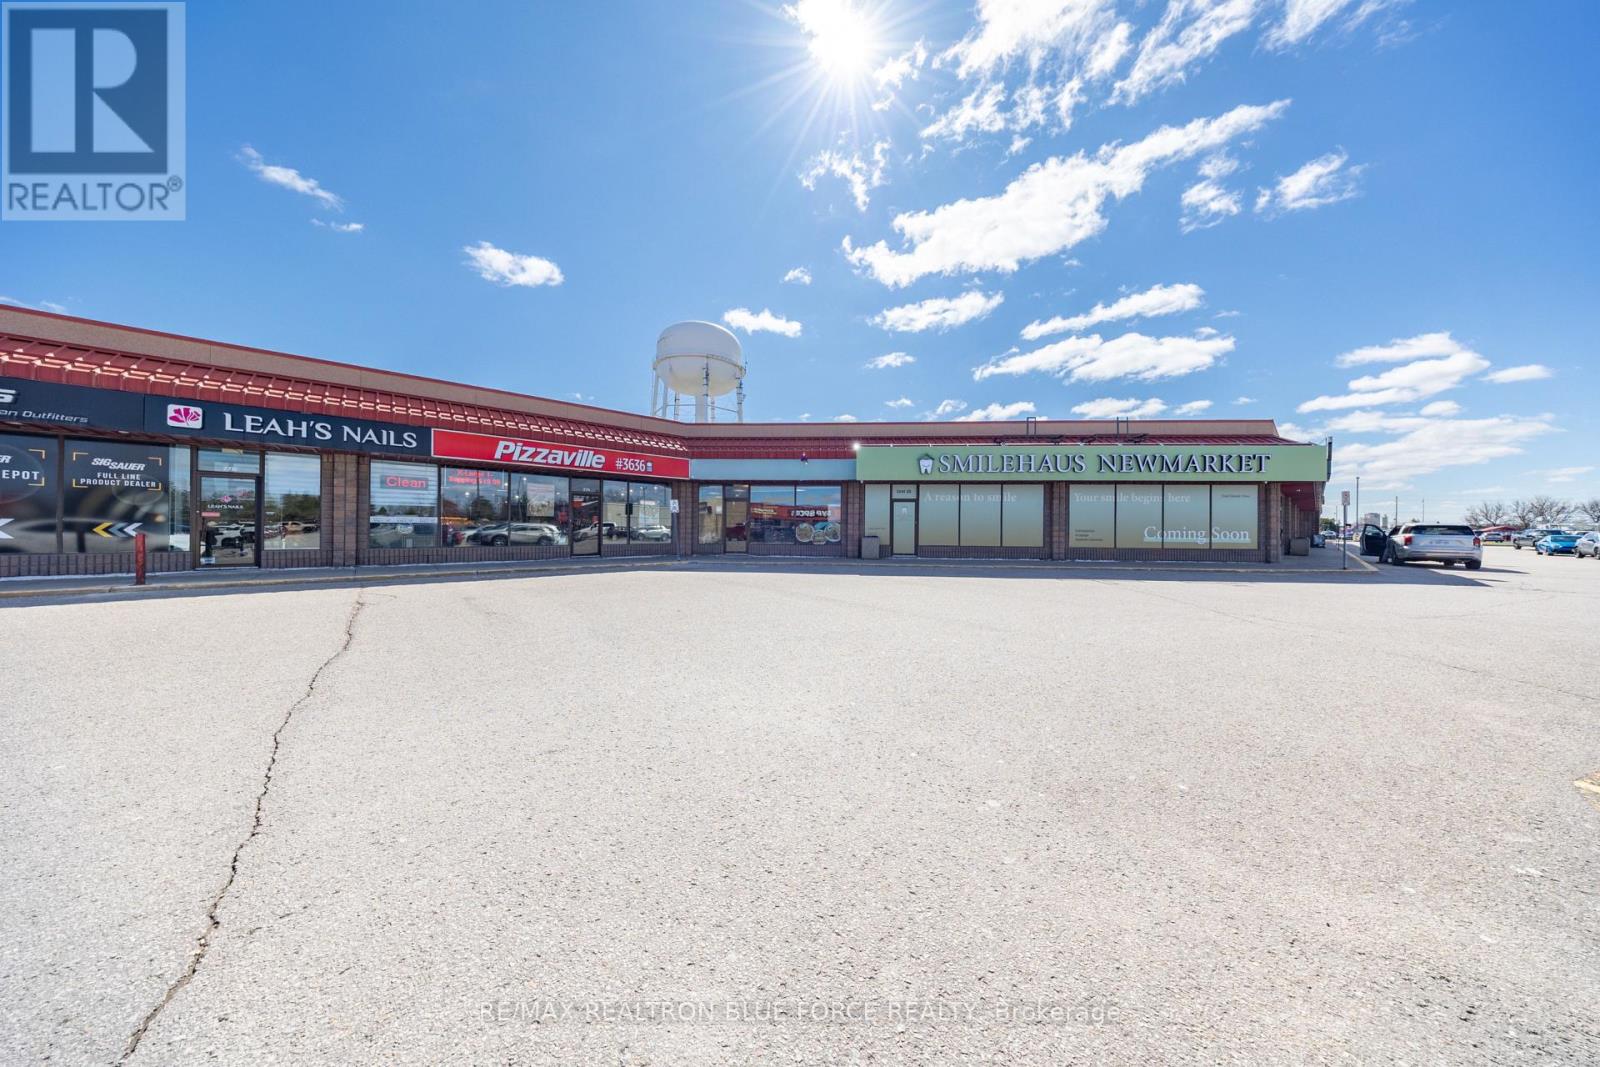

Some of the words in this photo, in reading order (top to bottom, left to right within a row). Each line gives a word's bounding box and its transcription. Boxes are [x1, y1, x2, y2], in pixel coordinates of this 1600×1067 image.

[22, 410, 89, 423] Outfitters
[223, 412, 332, 440] LEAH'S
[342, 425, 417, 448] NAILS
[494, 440, 606, 468] Pizzaville
[615, 457, 646, 472] #3636
[108, 462, 146, 471] SAUER
[938, 453, 1087, 474] SMILEHAUS
[1097, 453, 1271, 474] NEWMARKET
[80, 478, 121, 487] PRODUCT
[124, 480, 156, 488] DEALER
[97, 472, 118, 480] FULL
[121, 473, 141, 481] LINE
[385, 475, 427, 489] Clean
[1074, 492, 1099, 502] Your
[1167, 492, 1191, 503] here
[1144, 526, 1206, 544] Coming
[1211, 527, 1250, 541] Soon
